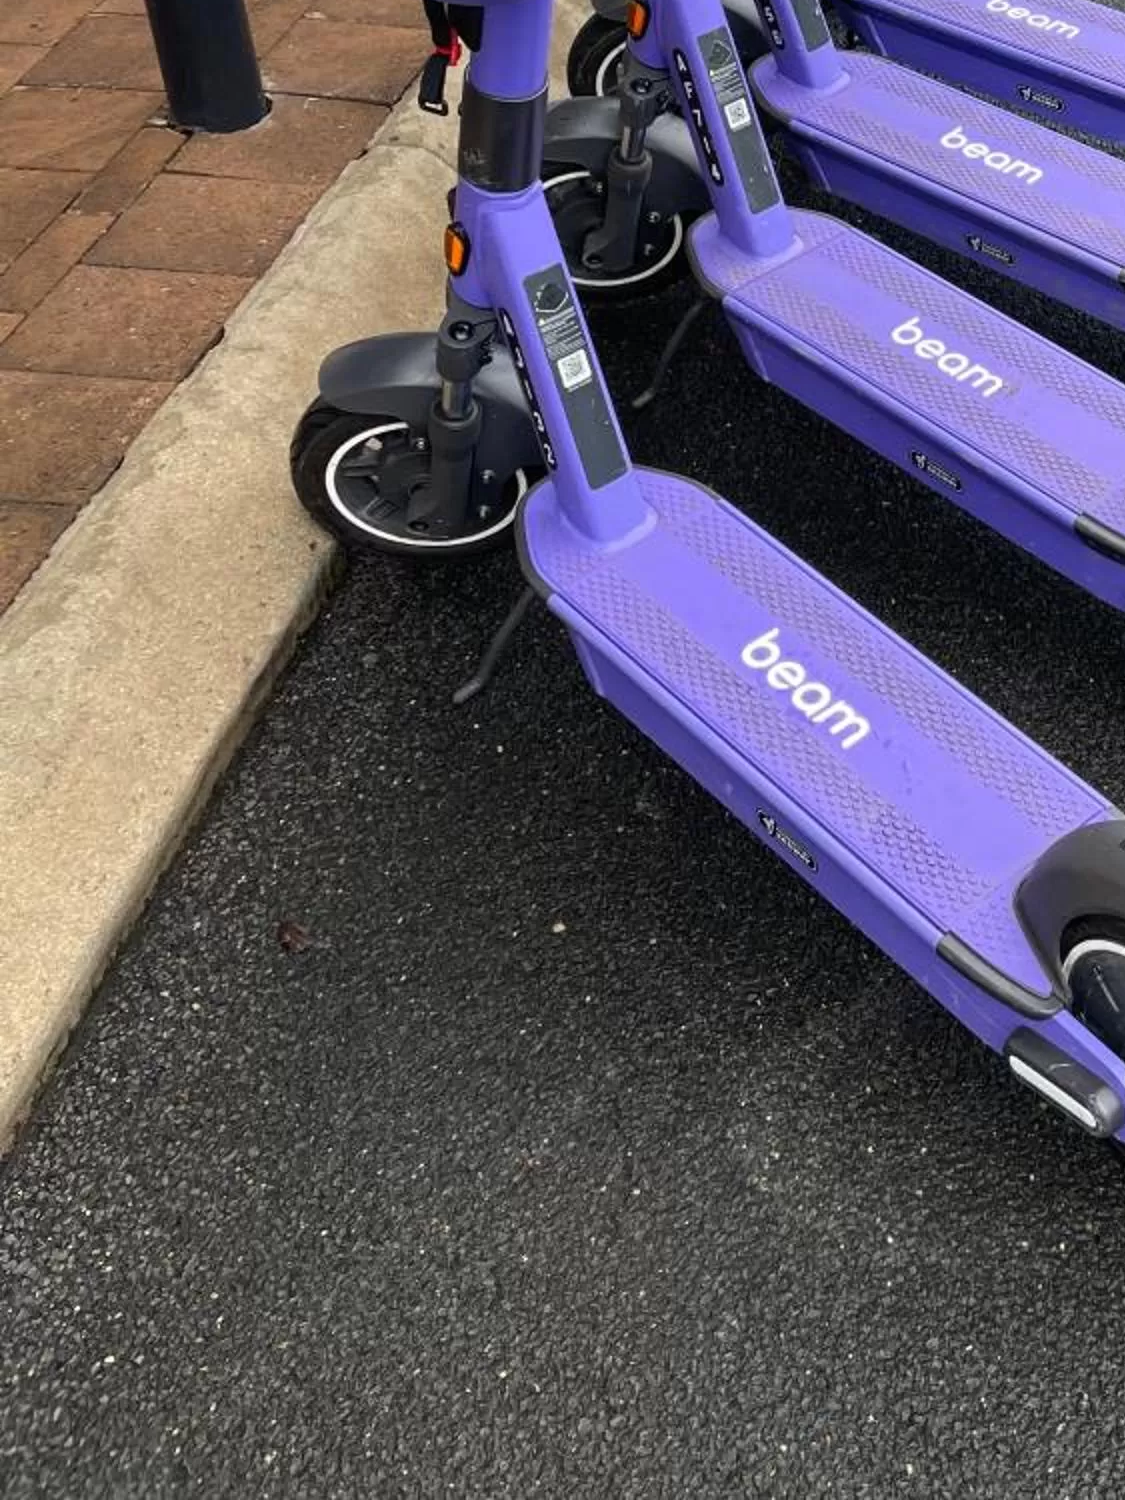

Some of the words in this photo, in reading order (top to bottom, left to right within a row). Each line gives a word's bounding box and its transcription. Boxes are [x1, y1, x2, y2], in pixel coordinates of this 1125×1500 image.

[940, 126, 1044, 186] beam
[891, 316, 1004, 398] beam
[741, 627, 871, 750] beam
